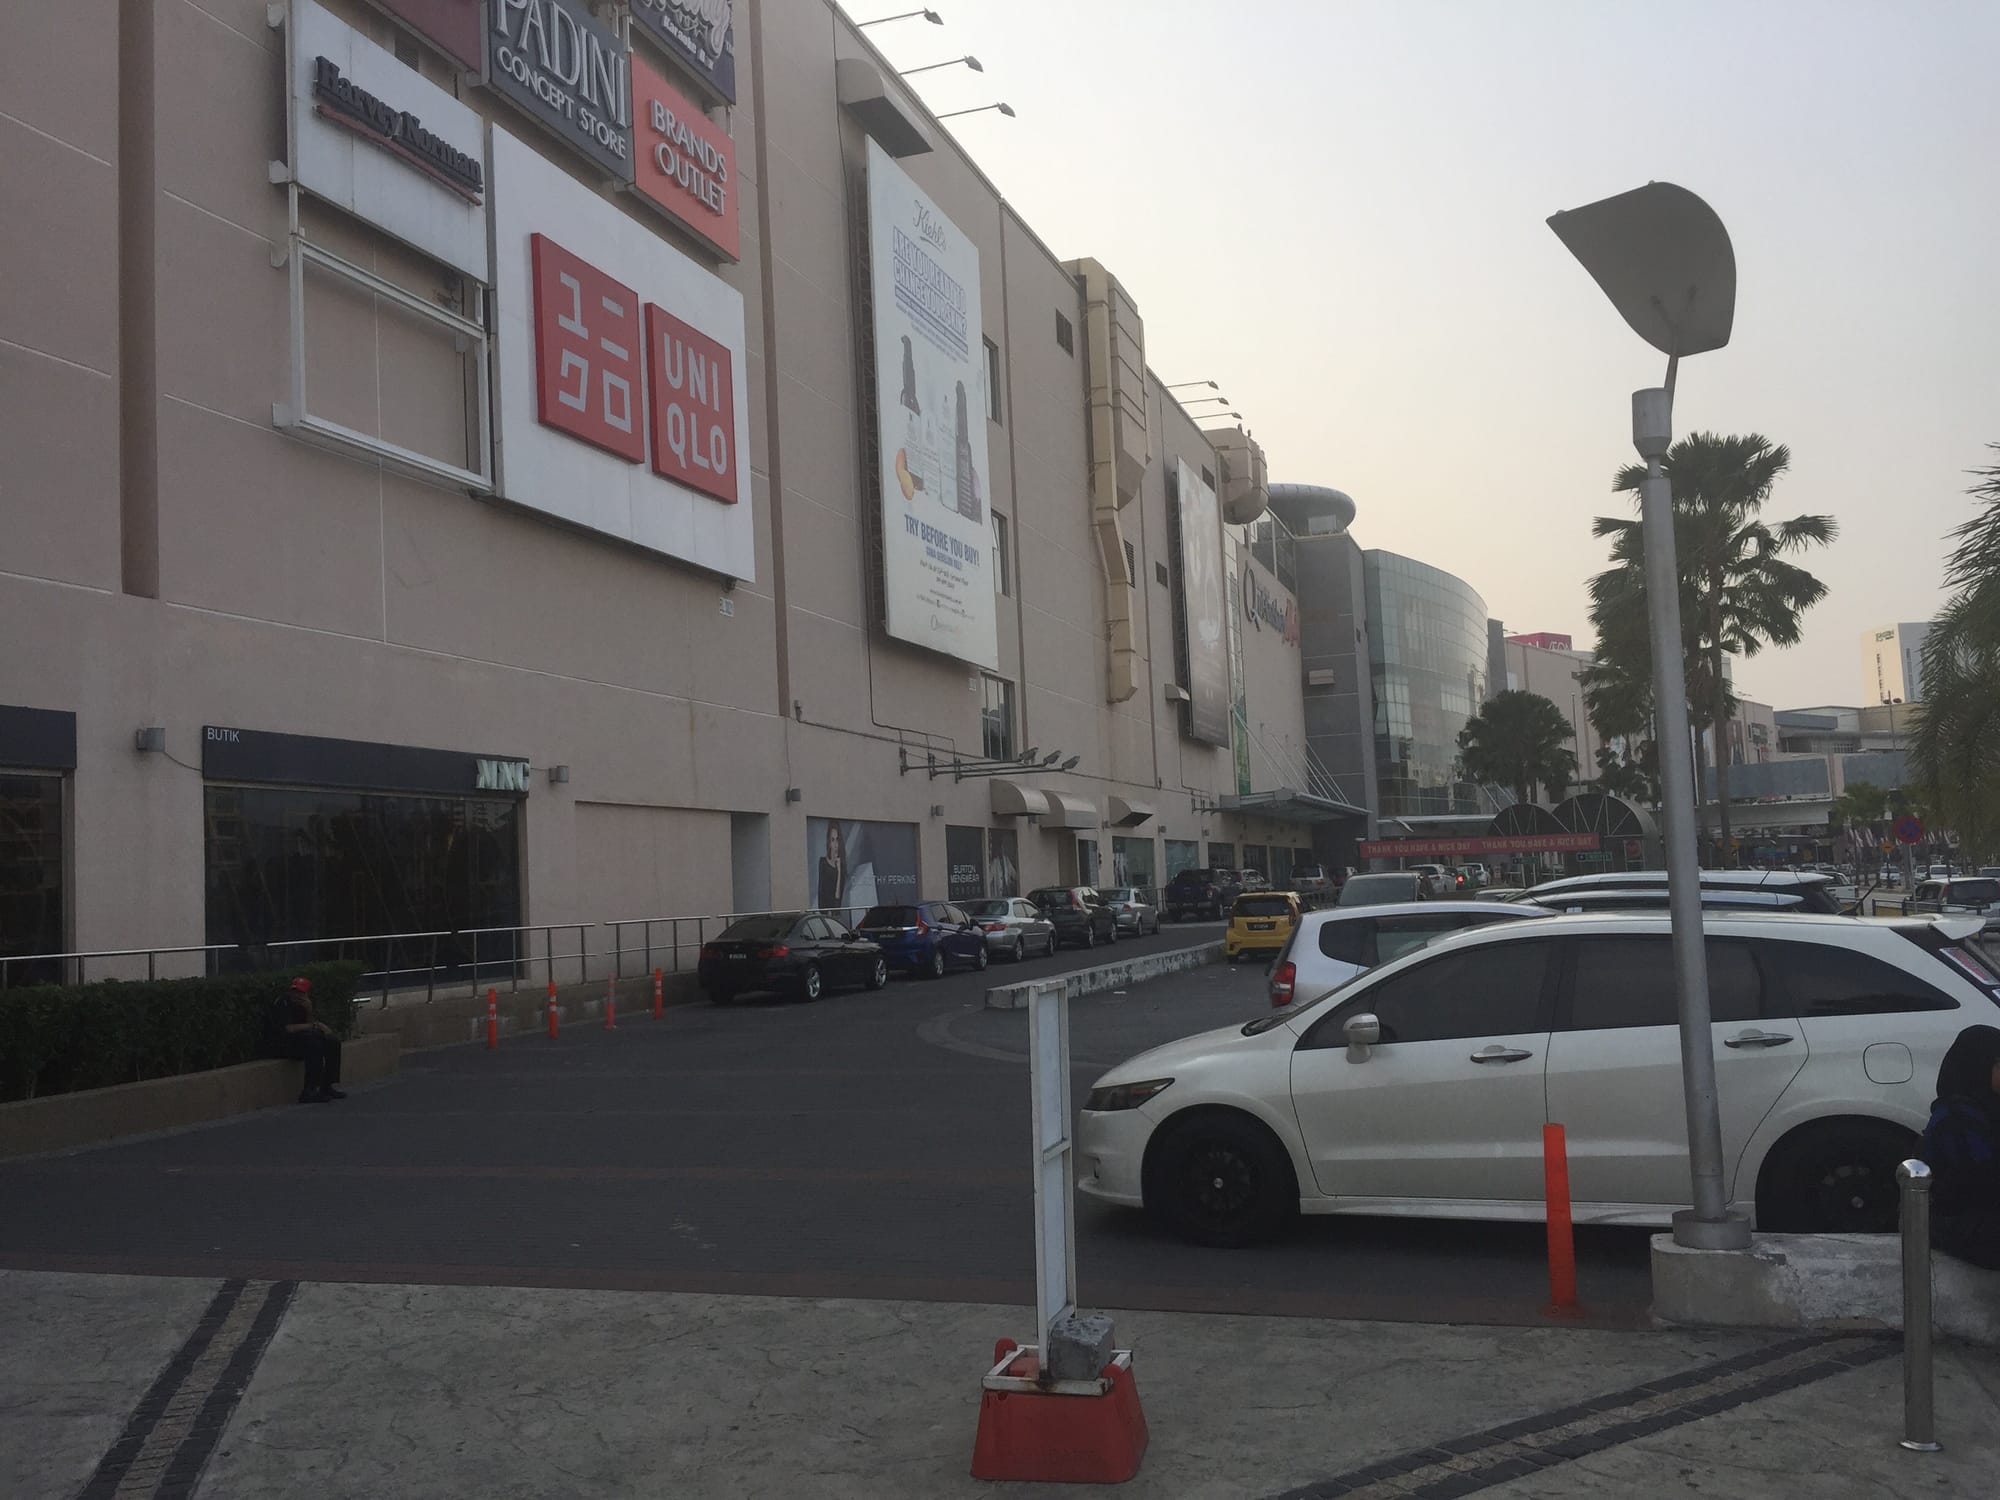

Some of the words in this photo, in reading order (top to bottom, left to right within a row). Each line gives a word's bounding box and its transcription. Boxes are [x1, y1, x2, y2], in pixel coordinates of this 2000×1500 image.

[315, 55, 401, 138] Harvey
[399, 111, 483, 186] Norman
[498, 46, 574, 119] CONCEPT
[579, 107, 626, 160] STORE
[652, 98, 727, 183] BRANDS
[656, 142, 726, 217] OUTLET
[664, 332, 720, 412] UNI
[667, 403, 727, 475] QLO
[904, 513, 919, 537] TRY
[921, 521, 948, 552] BEFORE
[949, 535, 963, 559] YOU
[964, 544, 980, 567] BUY!
[207, 727, 240, 743] BUTIK
[953, 864, 976, 874] BURTON
[1367, 845, 1392, 855] THANK
[1482, 840, 1508, 849] THANK
[851, 873, 887, 885] DTHY
[888, 874, 917, 885] PERKINS
[950, 873, 980, 884] MENSWEAR
